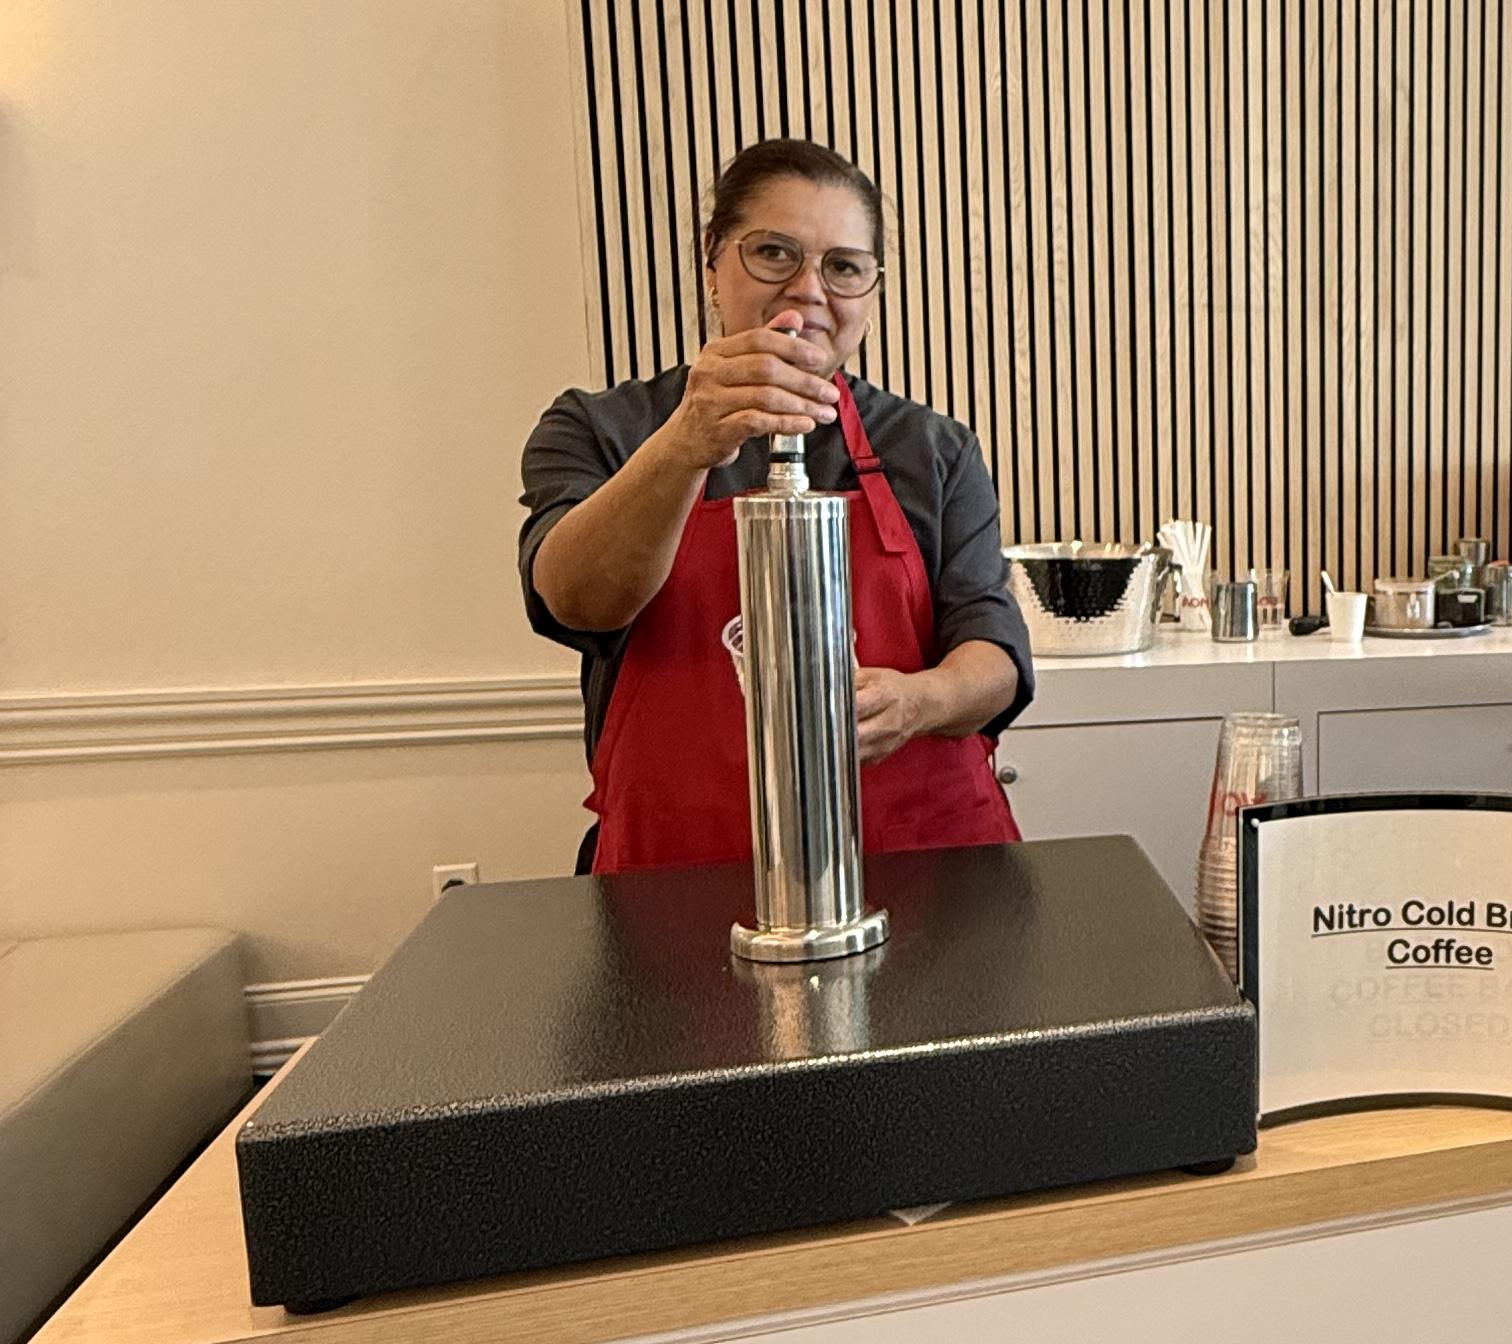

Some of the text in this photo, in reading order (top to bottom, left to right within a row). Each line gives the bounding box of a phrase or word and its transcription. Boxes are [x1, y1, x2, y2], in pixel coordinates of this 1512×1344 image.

[1313, 904, 1392, 932] Nitro
[1401, 900, 1475, 927] Cold
[1387, 938, 1493, 965] Coffee
